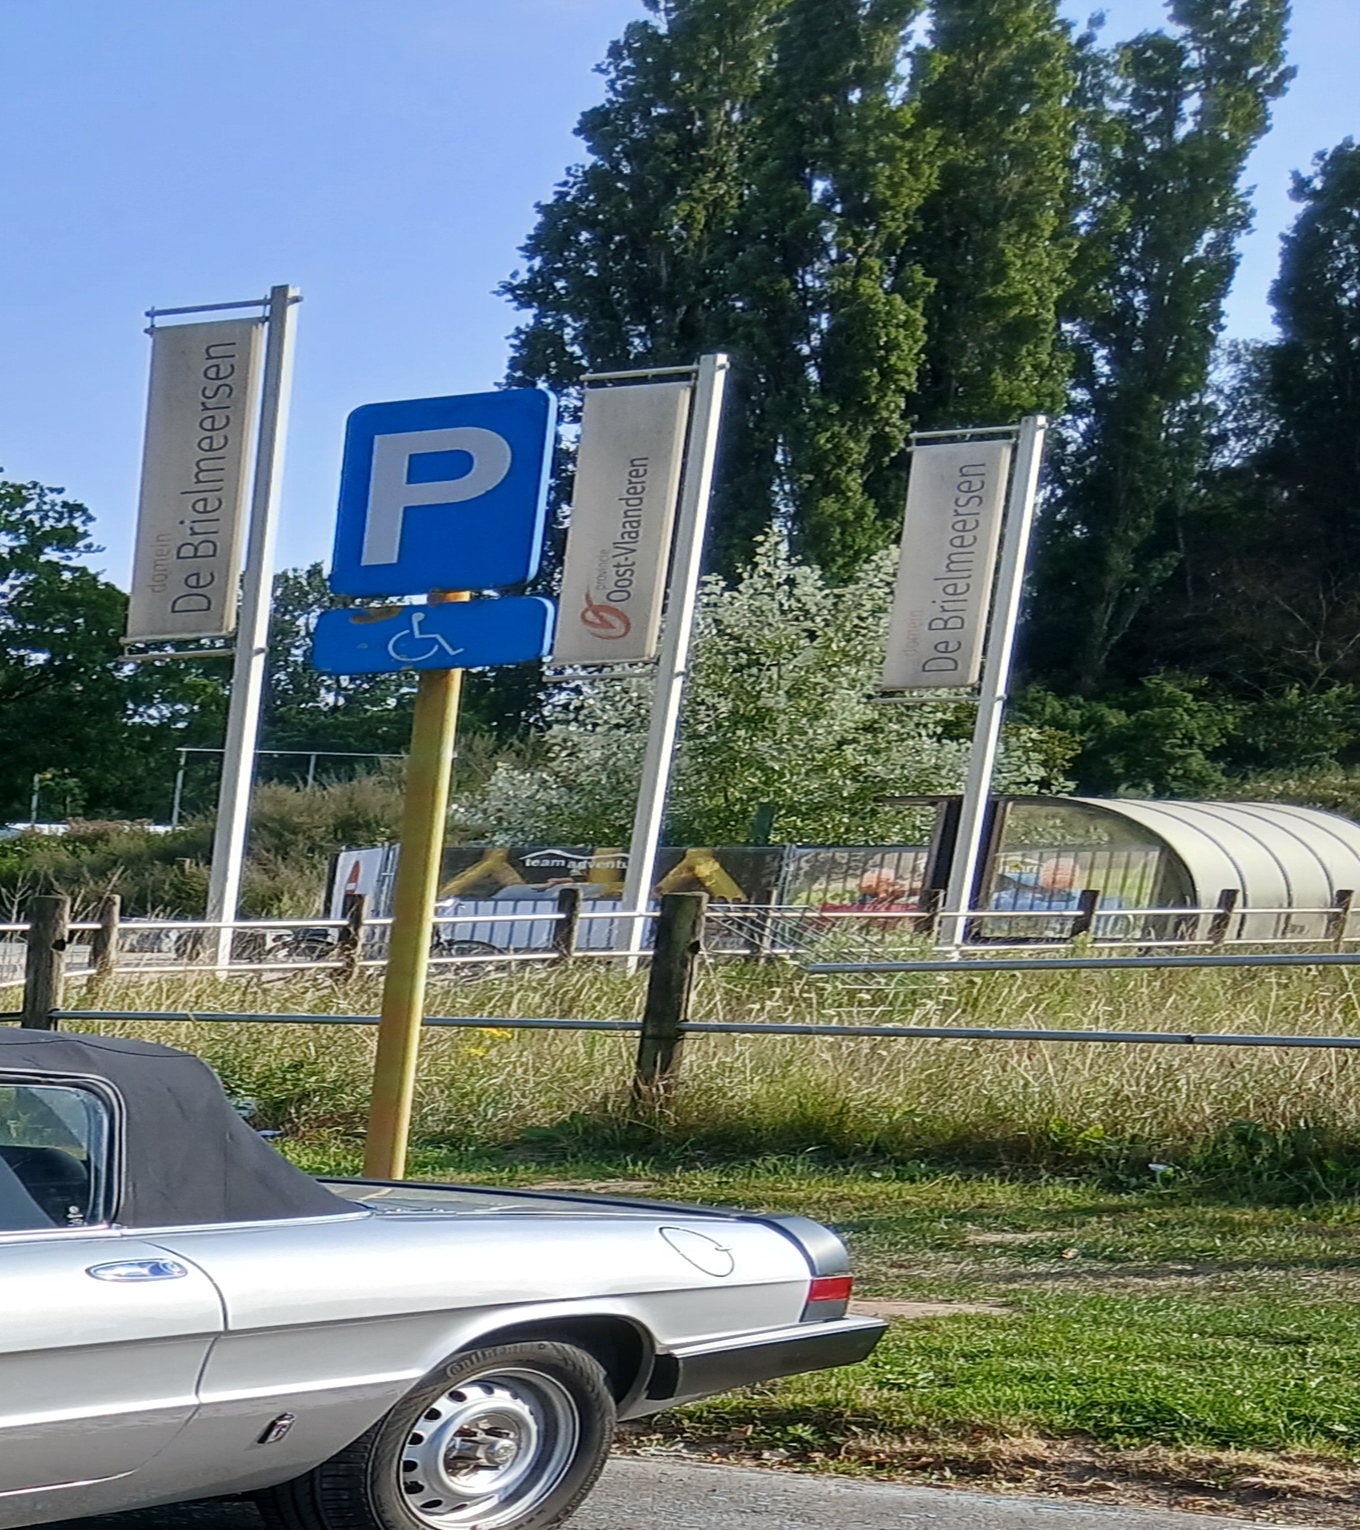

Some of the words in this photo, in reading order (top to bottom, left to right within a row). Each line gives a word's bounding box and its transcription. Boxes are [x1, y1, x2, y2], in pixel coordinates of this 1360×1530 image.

[177, 341, 237, 561] Brielmeersen
[361, 426, 512, 566] P
[606, 457, 649, 604] Oost-Vlaanderen
[928, 462, 986, 632] Brielmeersen
[147, 533, 172, 594] domein
[595, 549, 610, 591] provincie
[171, 571, 215, 614] De
[905, 610, 923, 658] domein
[922, 640, 962, 673] De
[525, 858, 565, 868] team
